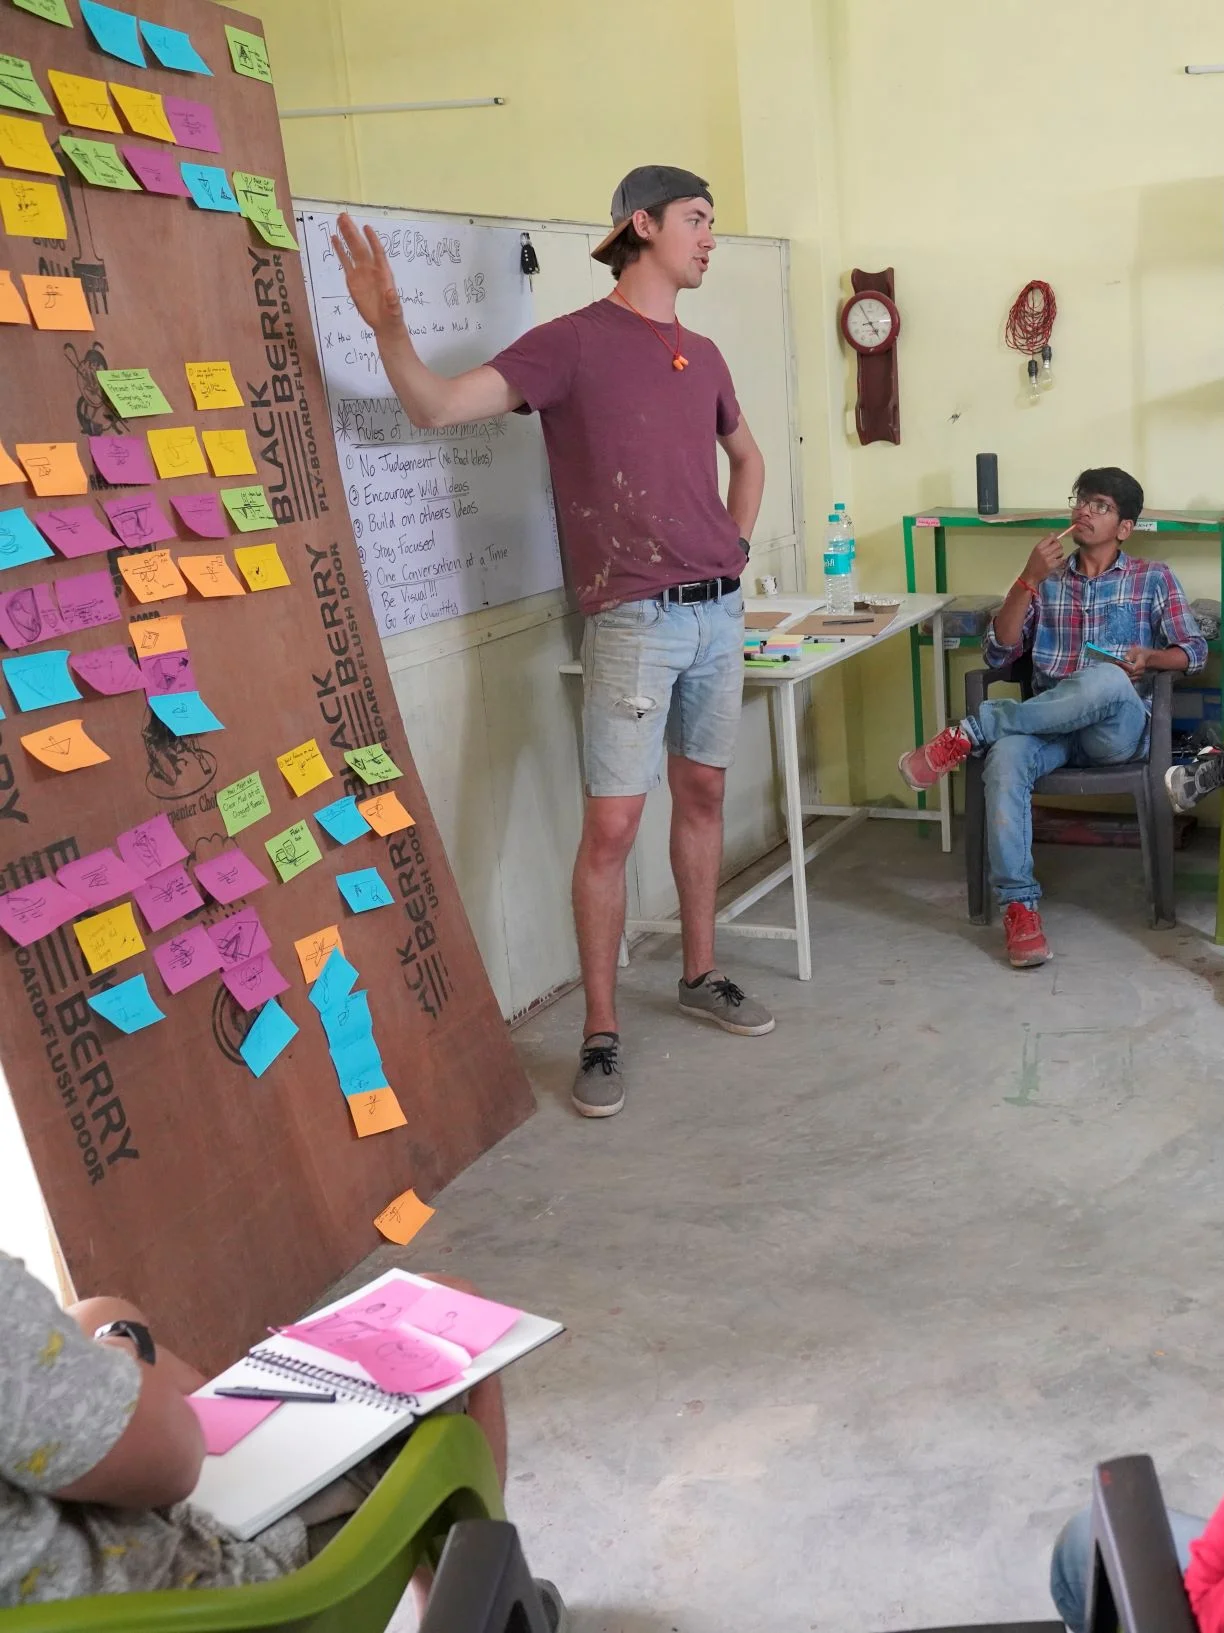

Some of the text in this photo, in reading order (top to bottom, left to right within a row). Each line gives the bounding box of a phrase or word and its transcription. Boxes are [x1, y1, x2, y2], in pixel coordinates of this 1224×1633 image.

[272, 253, 291, 313] DOOR
[247, 246, 295, 403] BERRY
[345, 348, 380, 375] Clogg
[355, 413, 385, 442] Rules
[360, 454, 376, 478] No
[378, 452, 436, 480] Judgement
[364, 483, 416, 506] Encourage
[418, 477, 439, 498] Wild
[444, 477, 470, 494] Ideas
[368, 512, 396, 532] Build
[401, 515, 416, 527] on
[453, 498, 479, 518] Ideas
[373, 542, 397, 564] Stay
[398, 530, 436, 556] Focused
[330, 542, 351, 600] DOOR
[376, 567, 397, 586] One
[401, 558, 463, 582] Conversation
[485, 543, 509, 562] Time
[304, 543, 360, 688] BERRY
[381, 591, 397, 612] Be
[385, 613, 397, 630] Go
[55, 989, 140, 1166] BERRY
[70, 1111, 105, 1187] DOOR
